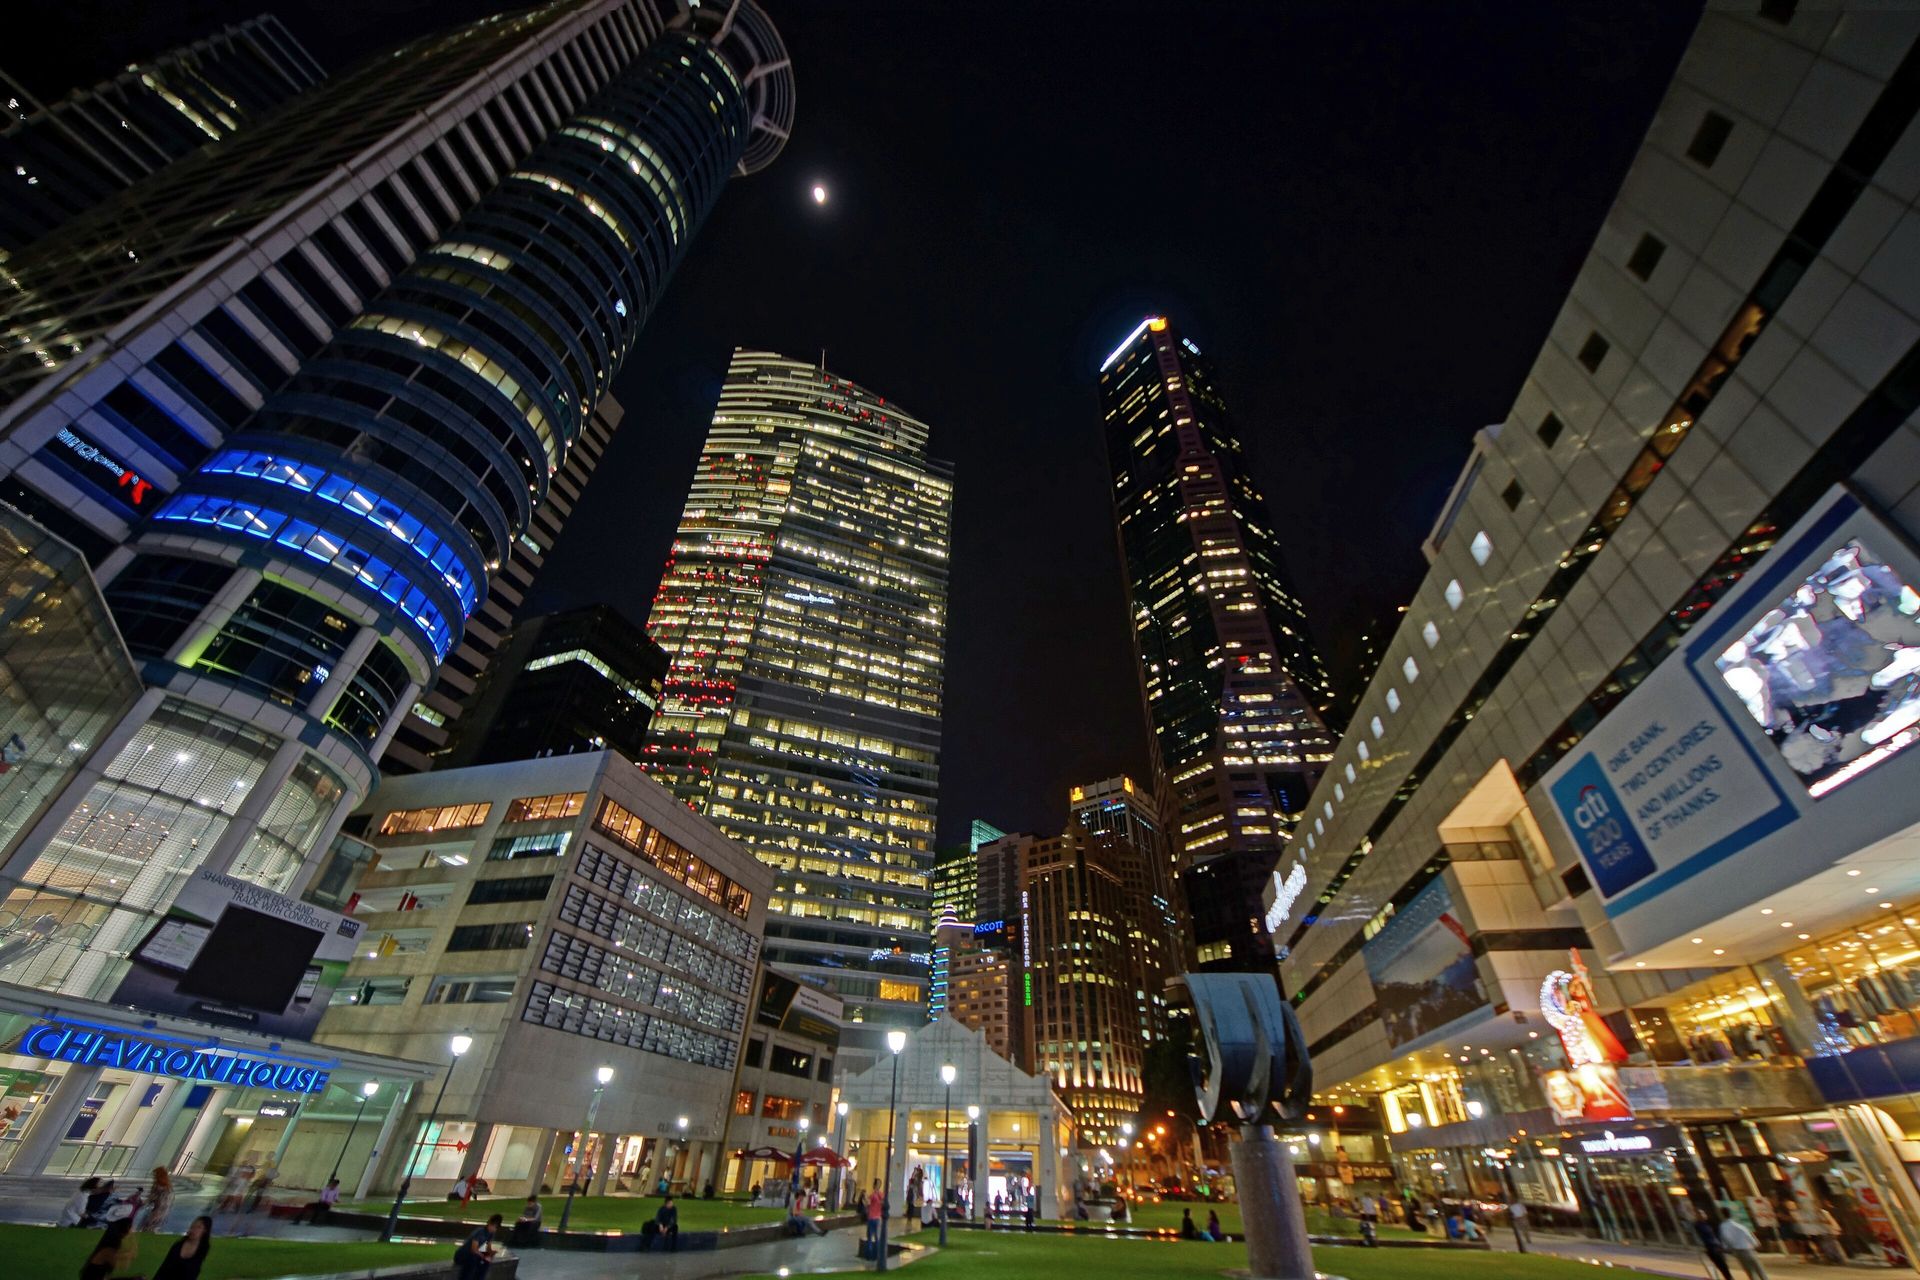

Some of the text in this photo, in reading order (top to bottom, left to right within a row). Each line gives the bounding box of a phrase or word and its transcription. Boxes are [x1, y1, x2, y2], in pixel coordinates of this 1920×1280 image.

[1607, 751, 1631, 773] ONE
[1619, 772, 1648, 796] TWO
[1636, 753, 1724, 821] AND MILLIONS
[1573, 790, 1611, 829] citi
[1586, 817, 1624, 855] 200
[1646, 820, 1663, 841] OF
[1598, 841, 1634, 870] YEARS
[201, 870, 315, 915] SHARPEN YOUR EDGE AND
[232, 891, 331, 931] TRADE WITH CONFIDENCE
[974, 920, 1004, 934] ASCOTT
[26, 1025, 329, 1094] CHEVRON HOUSE
